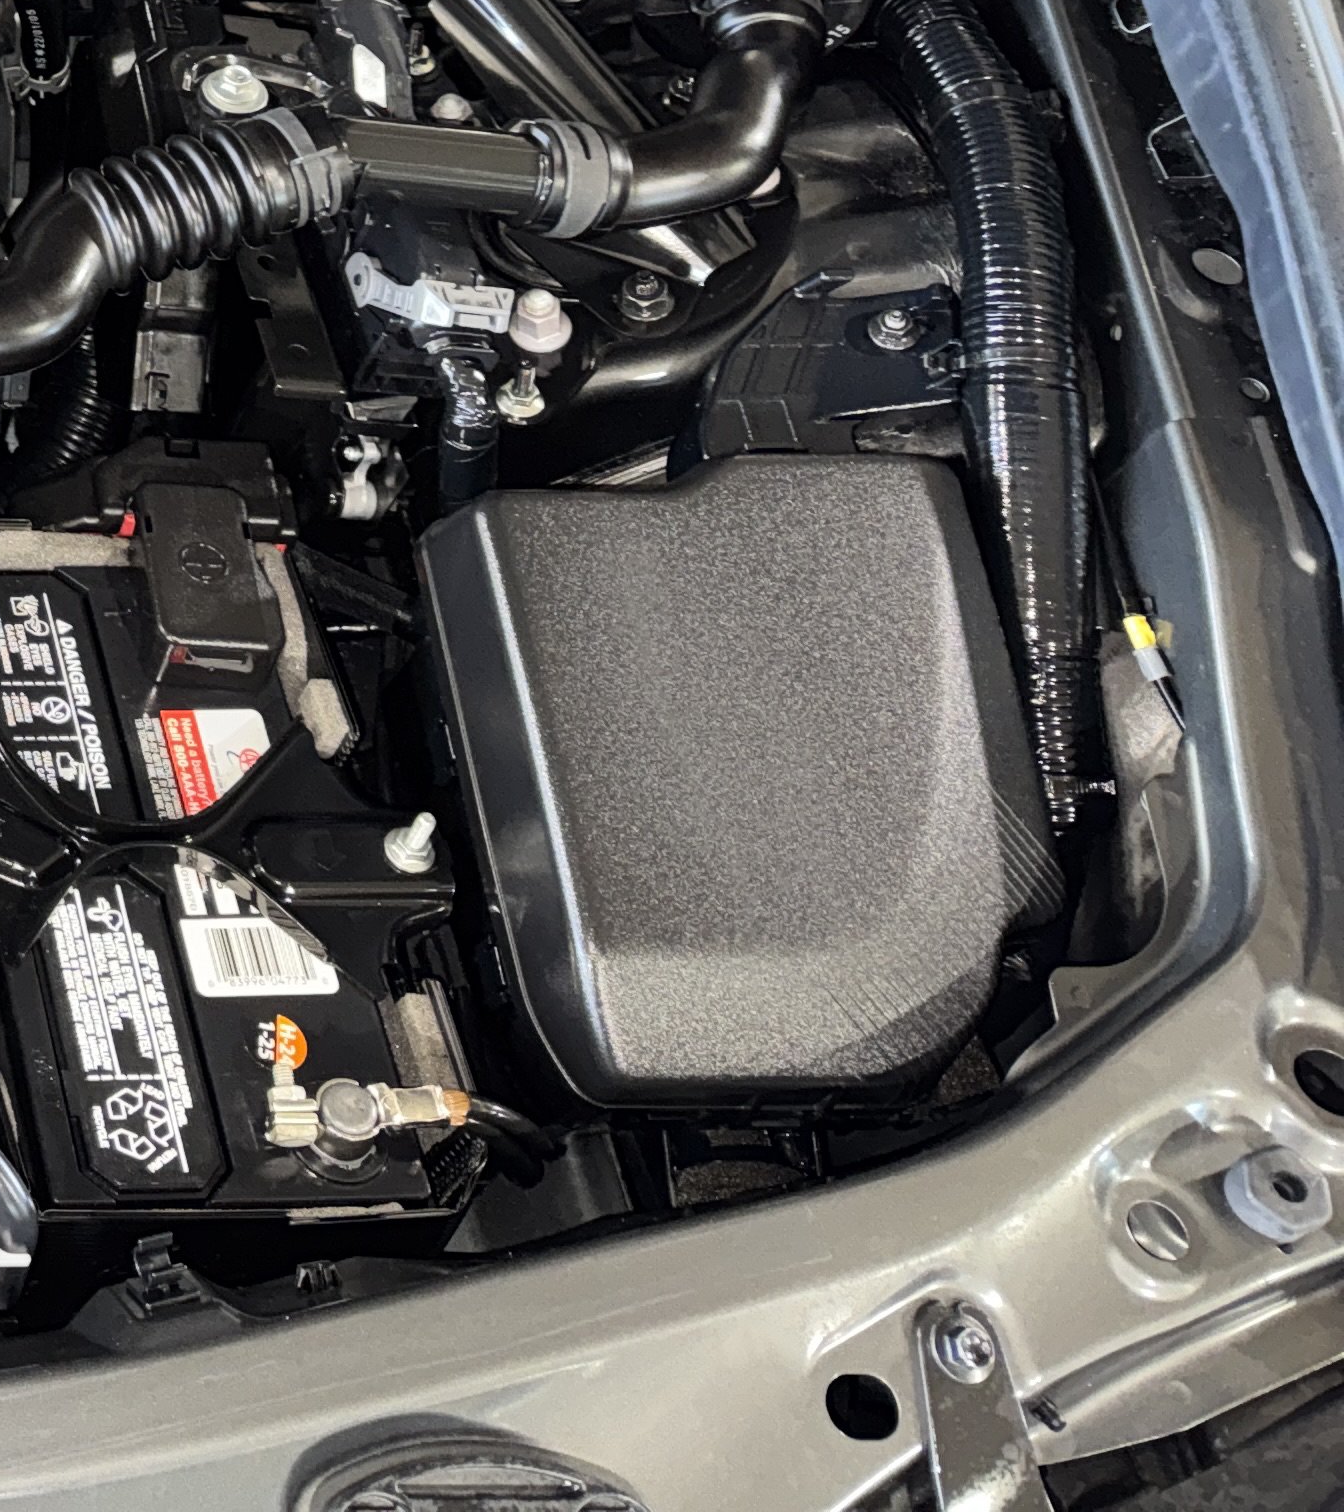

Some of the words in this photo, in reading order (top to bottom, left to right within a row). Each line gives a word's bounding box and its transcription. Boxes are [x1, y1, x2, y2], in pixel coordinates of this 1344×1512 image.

[60, 637, 91, 706] DANGER
[80, 723, 112, 790] POISON
[167, 718, 182, 741] Call
[180, 718, 197, 747] Need
[90, 932, 109, 974] MEDICAL
[113, 932, 131, 964] FLUSH
[100, 976, 117, 1003] HELP
[120, 966, 138, 991] EYES
[106, 1005, 124, 1031] FAST
[124, 994, 154, 1060] IMMEDIATELY
[257, 1022, 276, 1061] 1-25
[92, 1105, 110, 1149] RECYCLE
